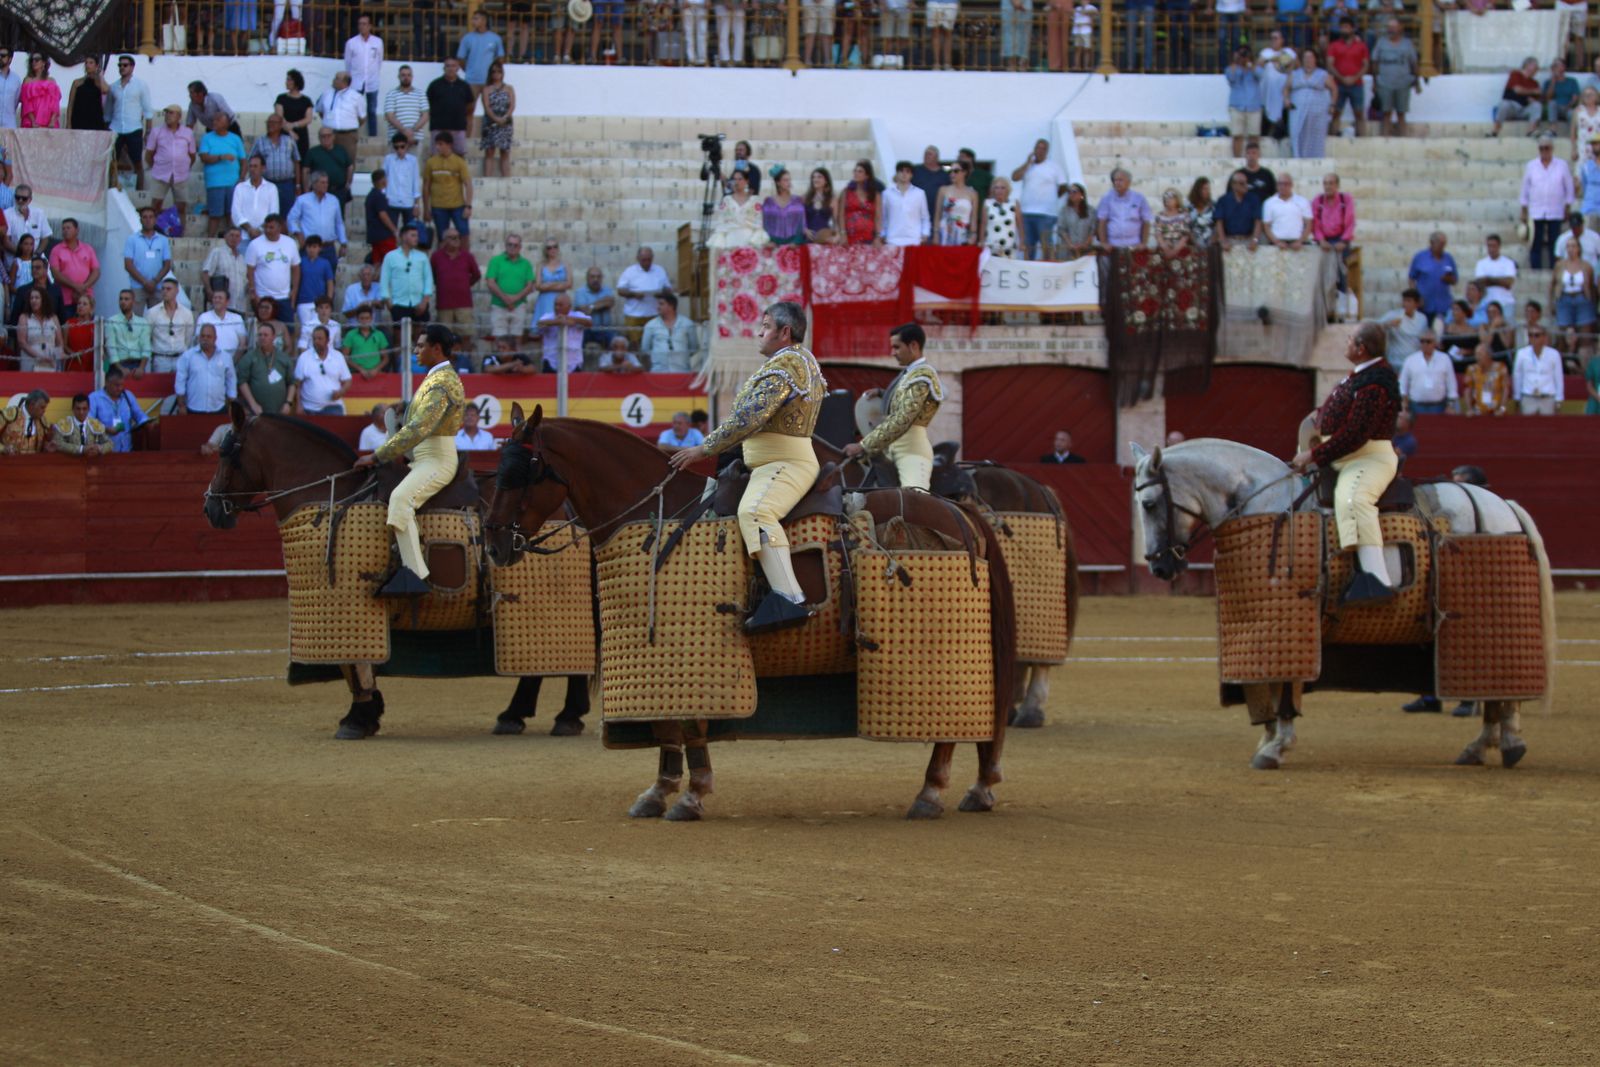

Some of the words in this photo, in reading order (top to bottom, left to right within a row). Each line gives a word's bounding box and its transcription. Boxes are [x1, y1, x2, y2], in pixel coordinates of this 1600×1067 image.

[1043, 279, 1062, 290] DE
[478, 397, 492, 425] 4
[626, 396, 643, 424] 4
